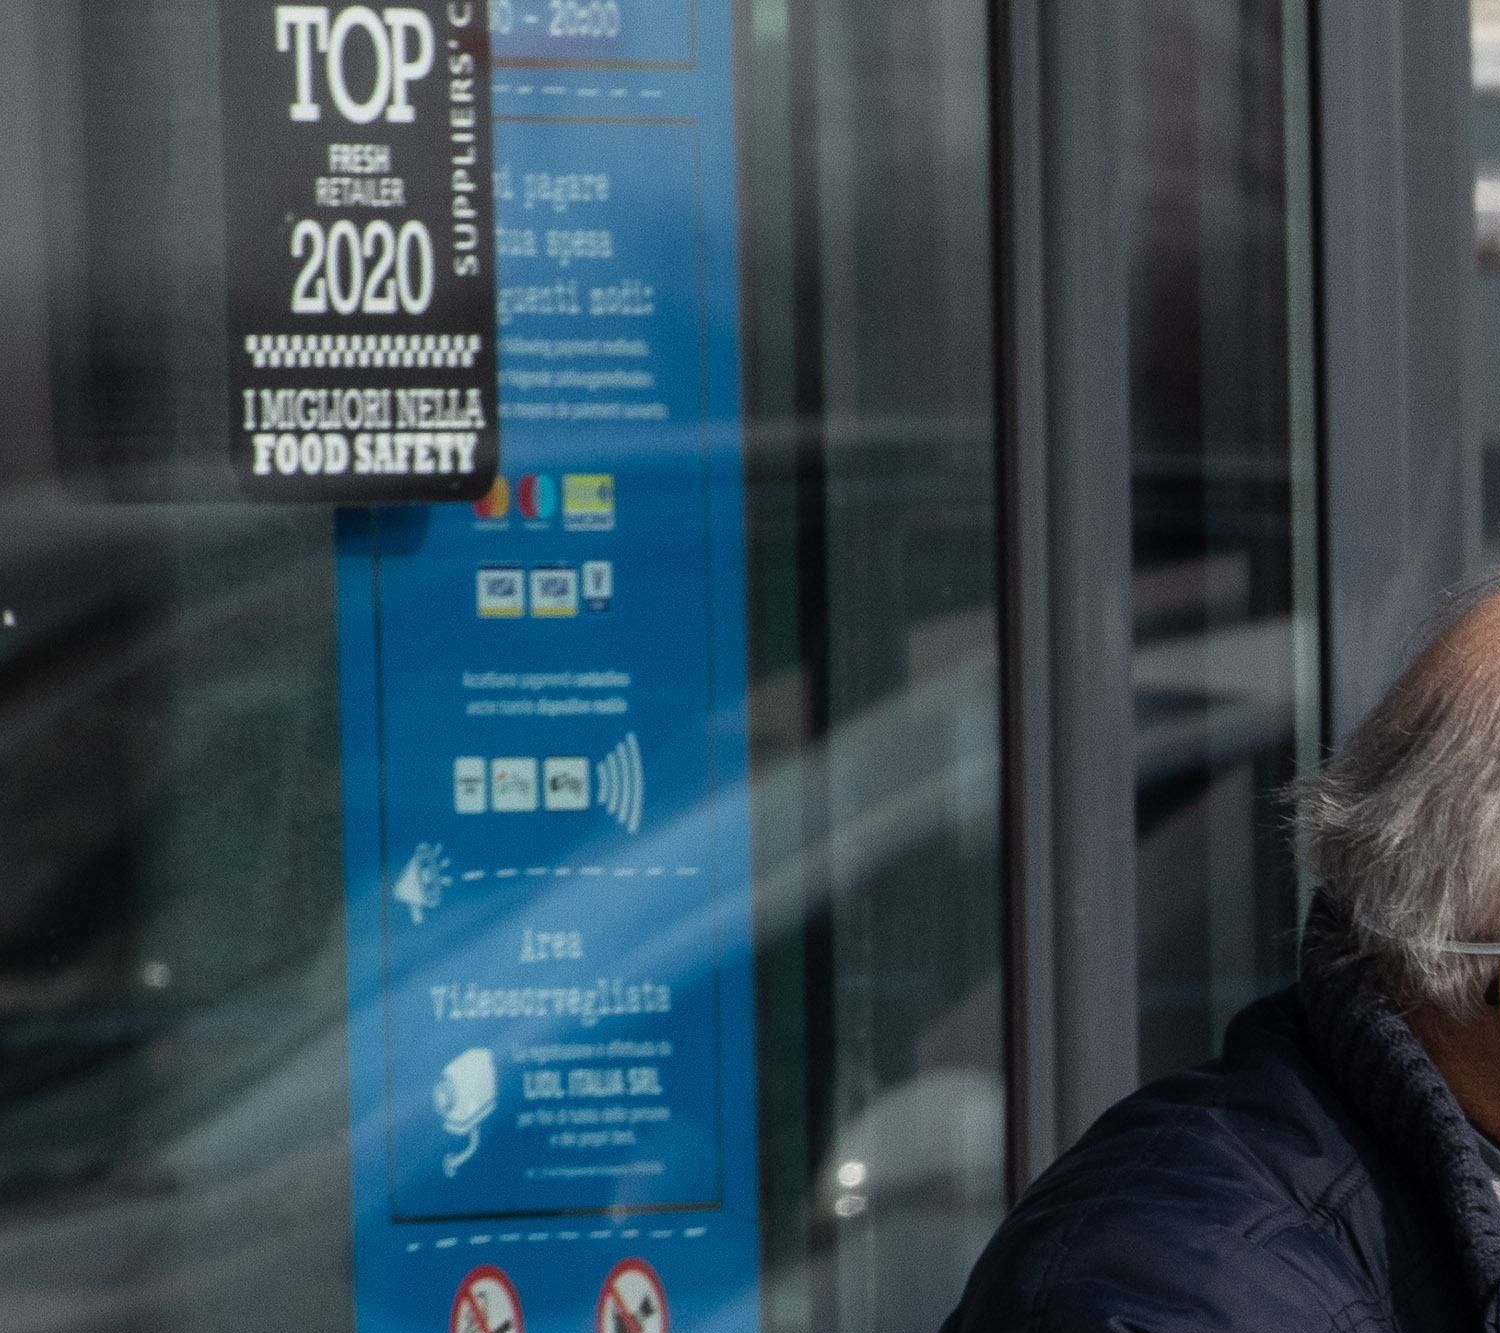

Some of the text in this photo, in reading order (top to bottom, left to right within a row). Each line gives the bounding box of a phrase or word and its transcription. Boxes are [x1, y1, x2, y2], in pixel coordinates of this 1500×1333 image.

[275, 6, 435, 124] TOP
[328, 143, 391, 174] FRESH
[447, 39, 480, 277] SUPPLIERS'
[315, 176, 406, 207] RETAILER
[290, 218, 435, 316] 2020
[243, 387, 486, 431] I MIGLIORI NELLA
[251, 431, 479, 475] FOOD SAFETY
[520, 927, 584, 963] Area
